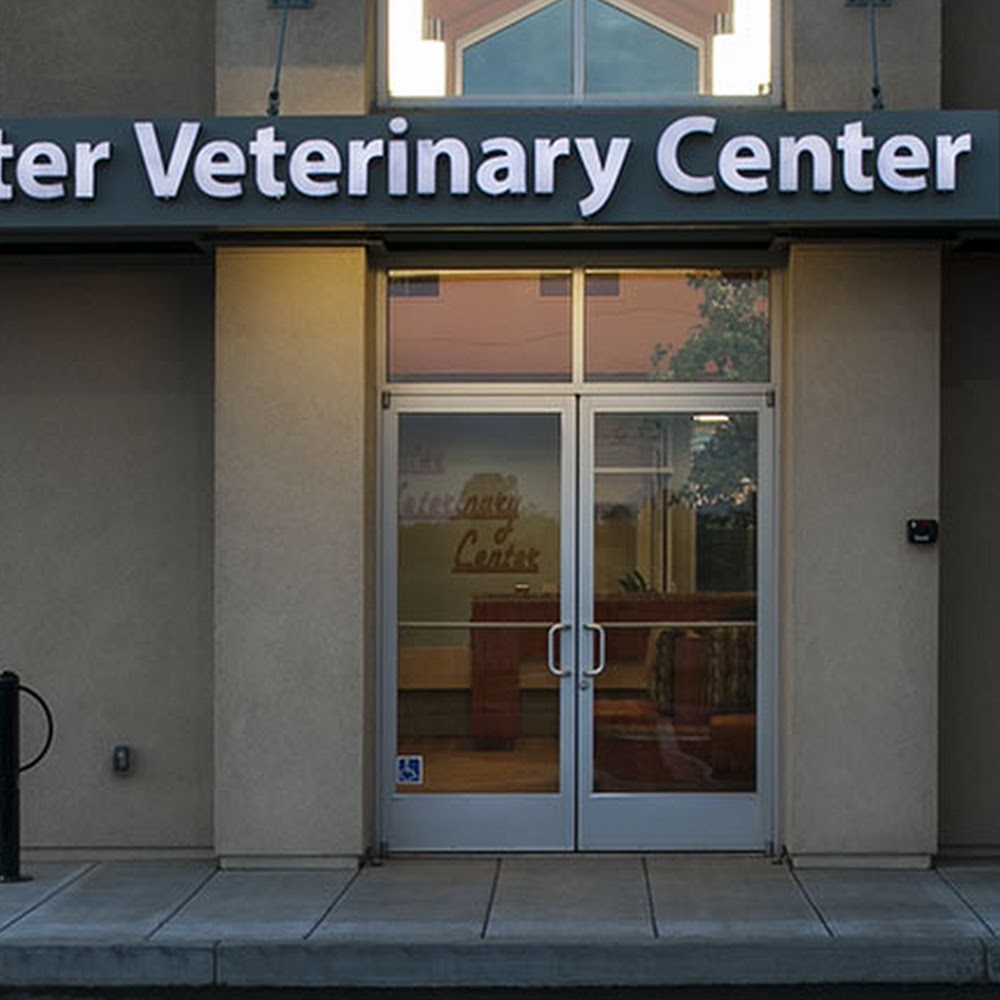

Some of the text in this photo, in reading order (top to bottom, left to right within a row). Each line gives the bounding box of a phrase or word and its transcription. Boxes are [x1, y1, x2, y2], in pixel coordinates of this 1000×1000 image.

[133, 116, 631, 217] Veterinary
[657, 115, 972, 195] Center
[453, 528, 541, 570] Center
